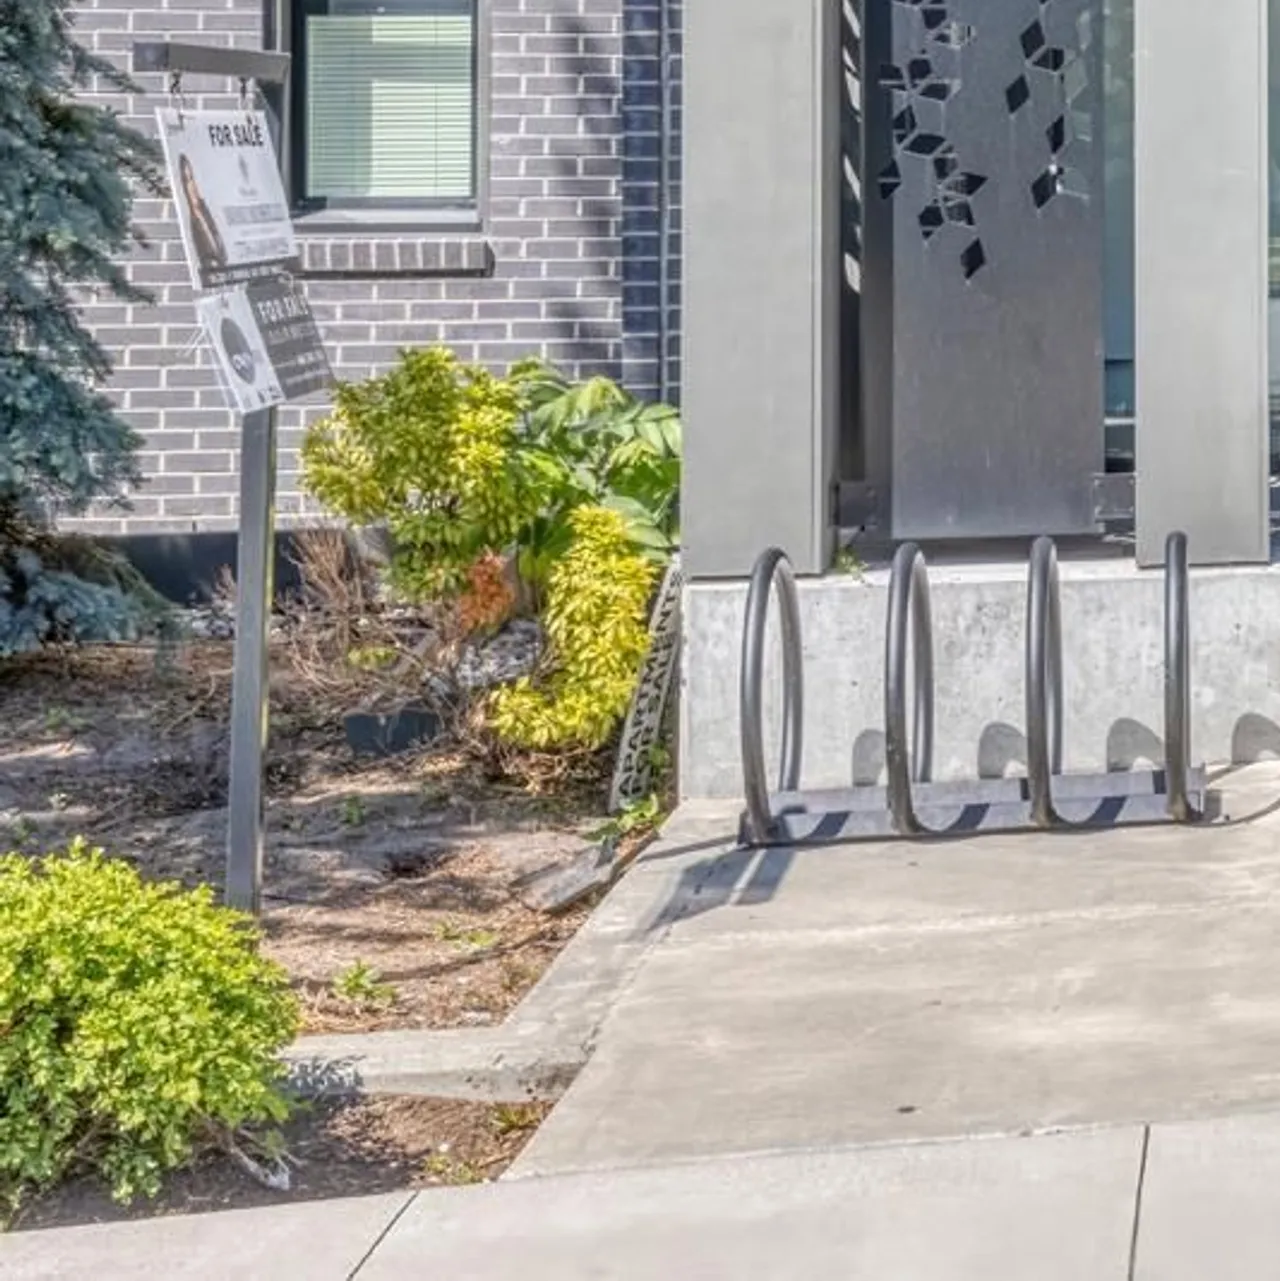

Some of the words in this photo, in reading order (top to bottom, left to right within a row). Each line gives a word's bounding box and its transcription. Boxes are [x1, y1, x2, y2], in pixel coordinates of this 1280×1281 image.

[208, 124, 233, 147] FOR
[233, 122, 264, 147] SALE
[257, 299, 285, 324] FOR
